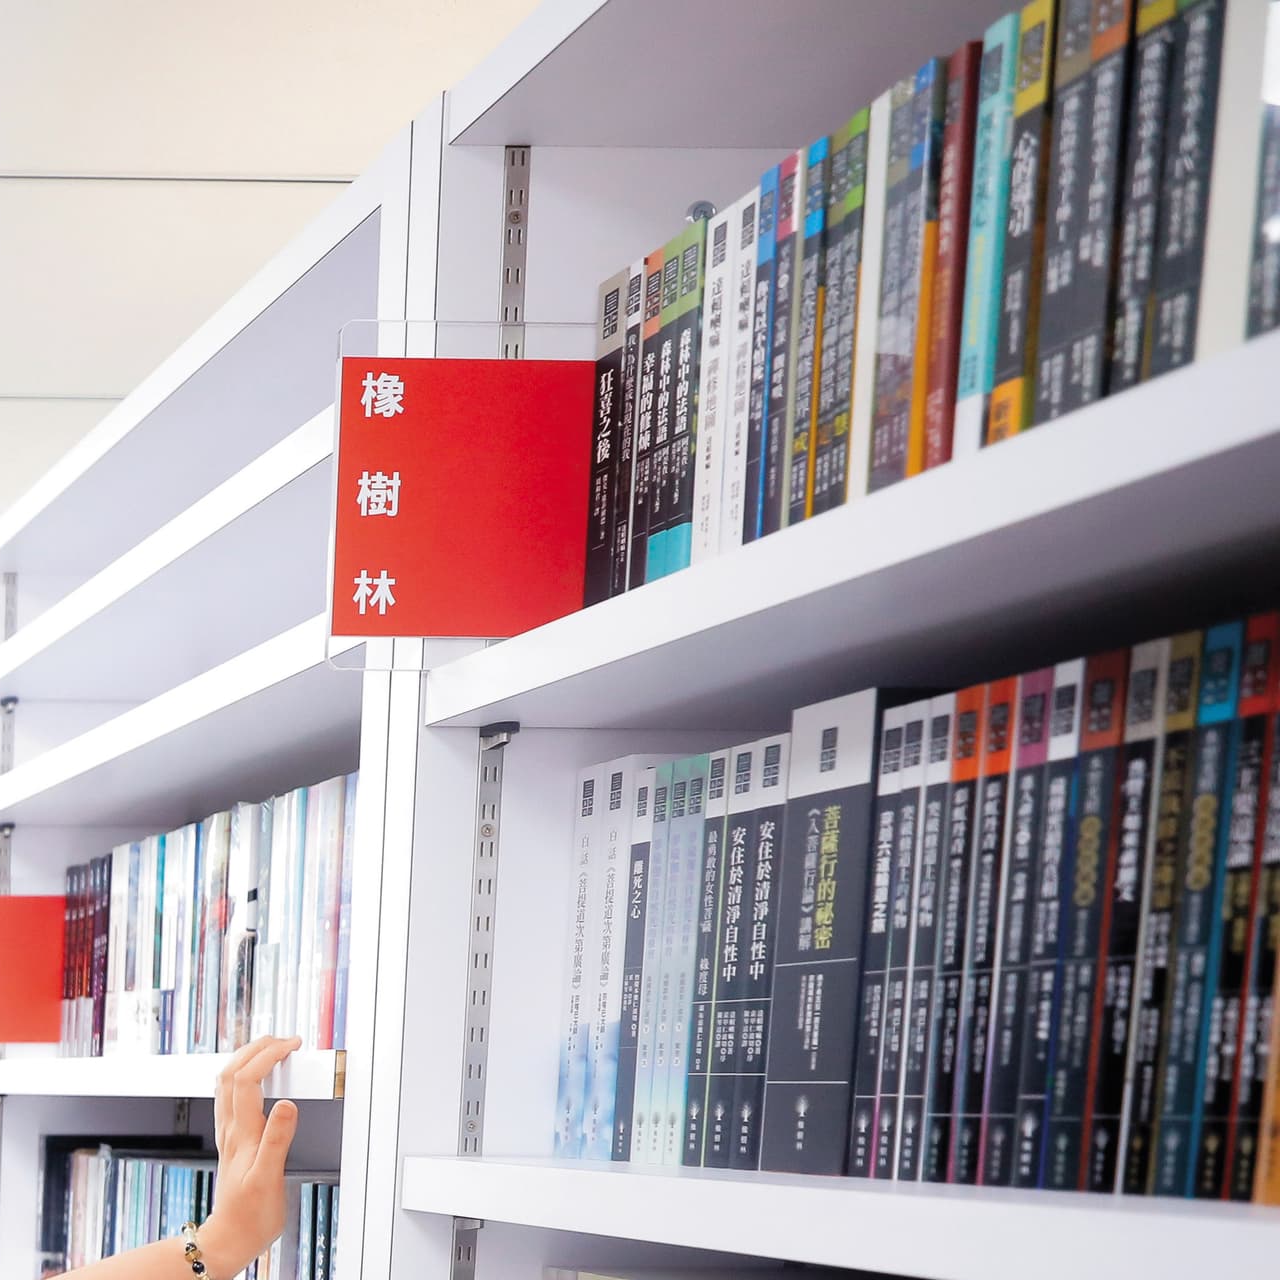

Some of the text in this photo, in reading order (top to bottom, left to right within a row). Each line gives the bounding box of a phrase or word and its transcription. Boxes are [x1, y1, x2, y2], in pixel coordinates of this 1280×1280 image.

[597, 369, 614, 464] 狂喜之後
[655, 337, 672, 446] 森林中的法語
[674, 327, 691, 435] 森林中的法語
[352, 372, 405, 616] 橡樹林
[722, 826, 746, 984] 安住於清淨自性中
[748, 820, 776, 981] 安住於清淨自性中
